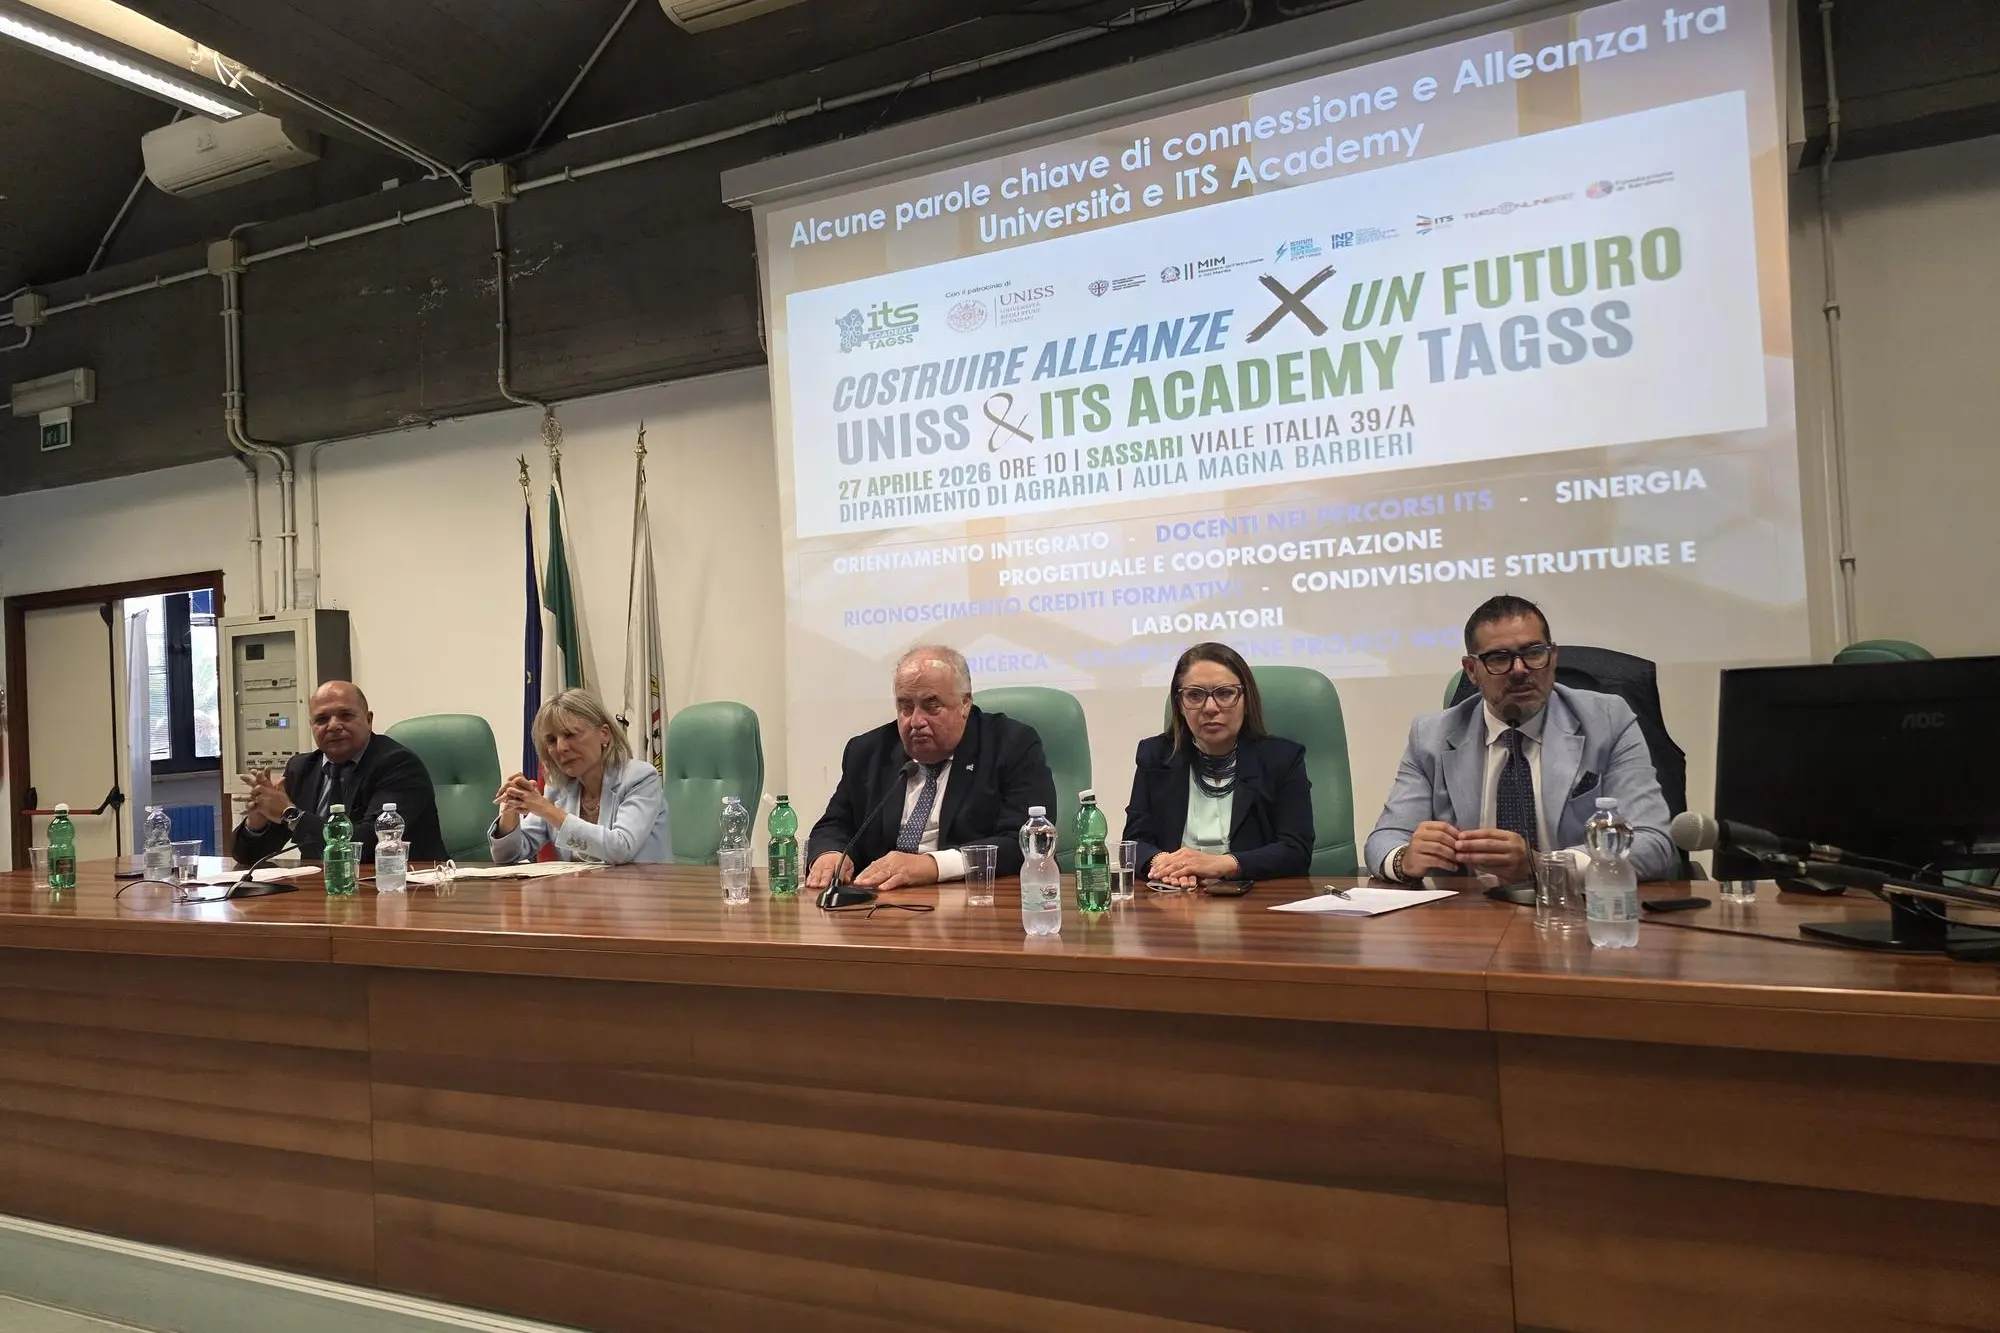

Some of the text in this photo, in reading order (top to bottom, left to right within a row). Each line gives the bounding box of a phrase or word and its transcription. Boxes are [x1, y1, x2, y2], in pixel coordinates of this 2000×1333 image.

[790, 4, 1727, 248] Alcune parole chiave di connessione e Alleanza tra
[980, 122, 1424, 243] Università e ITS Academy
[1434, 214, 1454, 225] ITS
[1197, 255, 1226, 269] MIM
[967, 282, 1003, 296] patrocinio
[1000, 285, 1055, 306] UNISS
[832, 346, 1029, 412] COSTRUIRE
[1031, 309, 1234, 382] ALLEANZE
[1342, 272, 1426, 332] UN
[1442, 227, 1680, 315] FUTURO
[867, 301, 919, 333] its
[868, 334, 915, 351] TAGSS
[837, 300, 1633, 465] UNISS & ITS ACADEMY TAGSS
[839, 481, 861, 500] 27
[866, 470, 933, 498] APRILE
[939, 462, 991, 490] 2026
[1000, 455, 1036, 481] ORE
[1045, 451, 1067, 475] 10
[1087, 435, 1183, 469] SASSARI
[1191, 425, 1254, 454] VIALE
[1265, 413, 1339, 444] ITALIA
[1350, 404, 1416, 433] 39/A
[839, 489, 981, 523] DIPARTIMENTO
[988, 484, 1008, 504] DI
[1014, 471, 1109, 503] AGRARIA
[1133, 461, 1189, 489] AULA
[1199, 444, 1284, 481] MAGNA
[1295, 432, 1414, 469] BARBIERI
[833, 543, 984, 575] ORIENTAMENTO
[992, 531, 1109, 560] INTEGRATO
[1155, 513, 1259, 543] DOCENTI
[1453, 490, 1493, 513] ITS
[1555, 468, 1707, 503] SINERGIA
[998, 529, 1443, 587] PROGETTUALE E COOPROGETTAZIONE
[843, 599, 1021, 628] RICONOSCIMENTO
[1028, 590, 1106, 614] CREDITI
[1292, 557, 1496, 593] CONDIVISIONE
[1505, 542, 1670, 577] STRUTTURE
[1680, 540, 1696, 563] E
[1131, 607, 1284, 637] LABORATORI
[967, 652, 1049, 673] RICERCA
[1902, 711, 1945, 730] AOC
